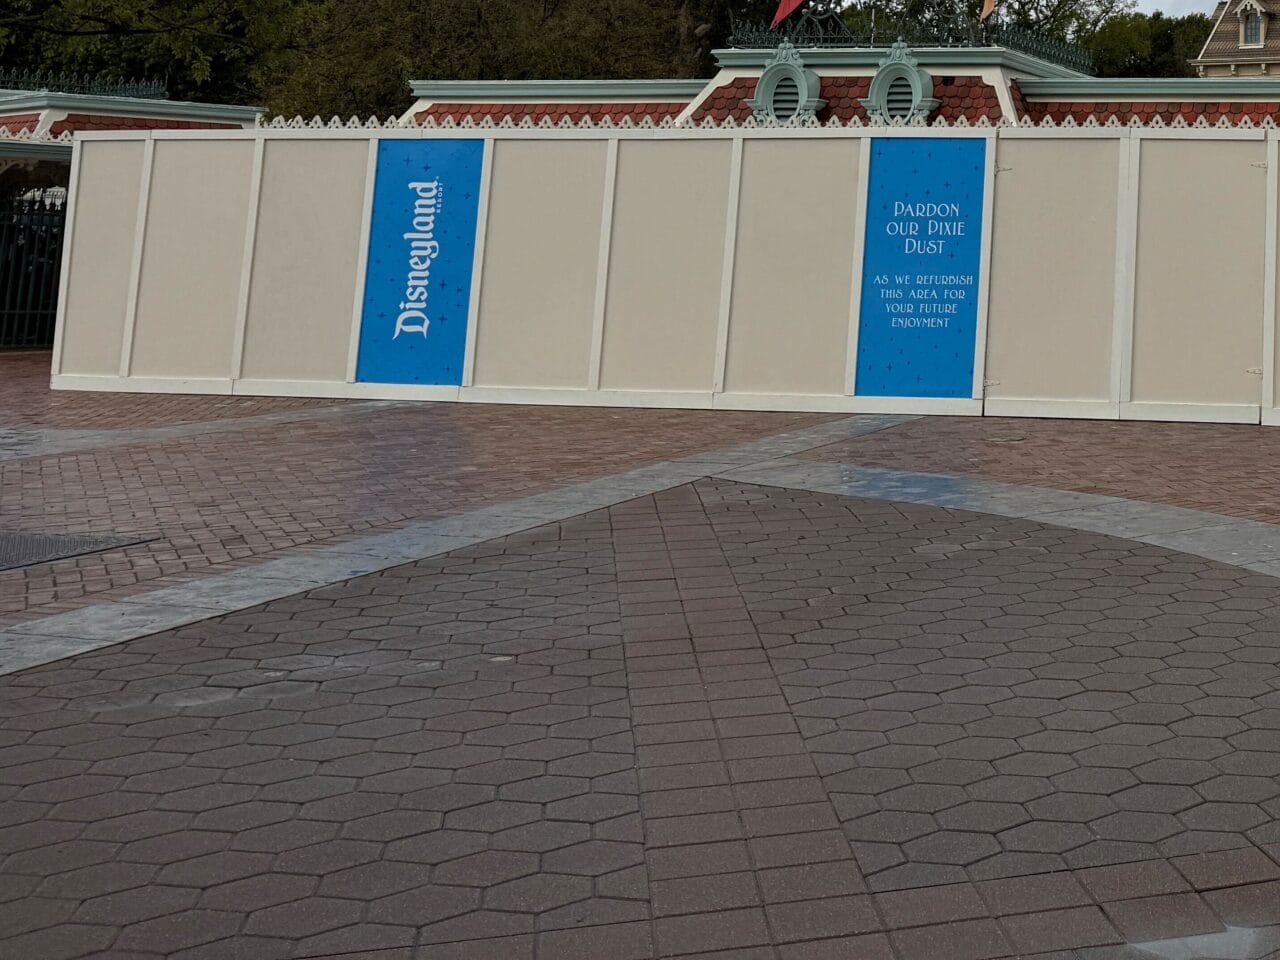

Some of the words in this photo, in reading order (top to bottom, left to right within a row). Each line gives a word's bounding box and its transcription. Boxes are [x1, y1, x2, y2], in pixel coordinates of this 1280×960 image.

[894, 201, 960, 217] PARDON
[886, 221, 919, 236] OUR
[928, 219, 965, 236] PIXIE
[905, 238, 946, 254] DUST
[392, 180, 440, 340] Disneyland
[874, 275, 889, 285] AS
[895, 275, 910, 285] WE
[916, 275, 973, 286] REFURBISH
[880, 288, 903, 299] THIS
[909, 289, 938, 299] AREA
[944, 289, 966, 299] FOR
[885, 303, 914, 313] YOUR
[919, 304, 958, 314] FUTURE
[891, 317, 950, 328] ENJOYMENT
